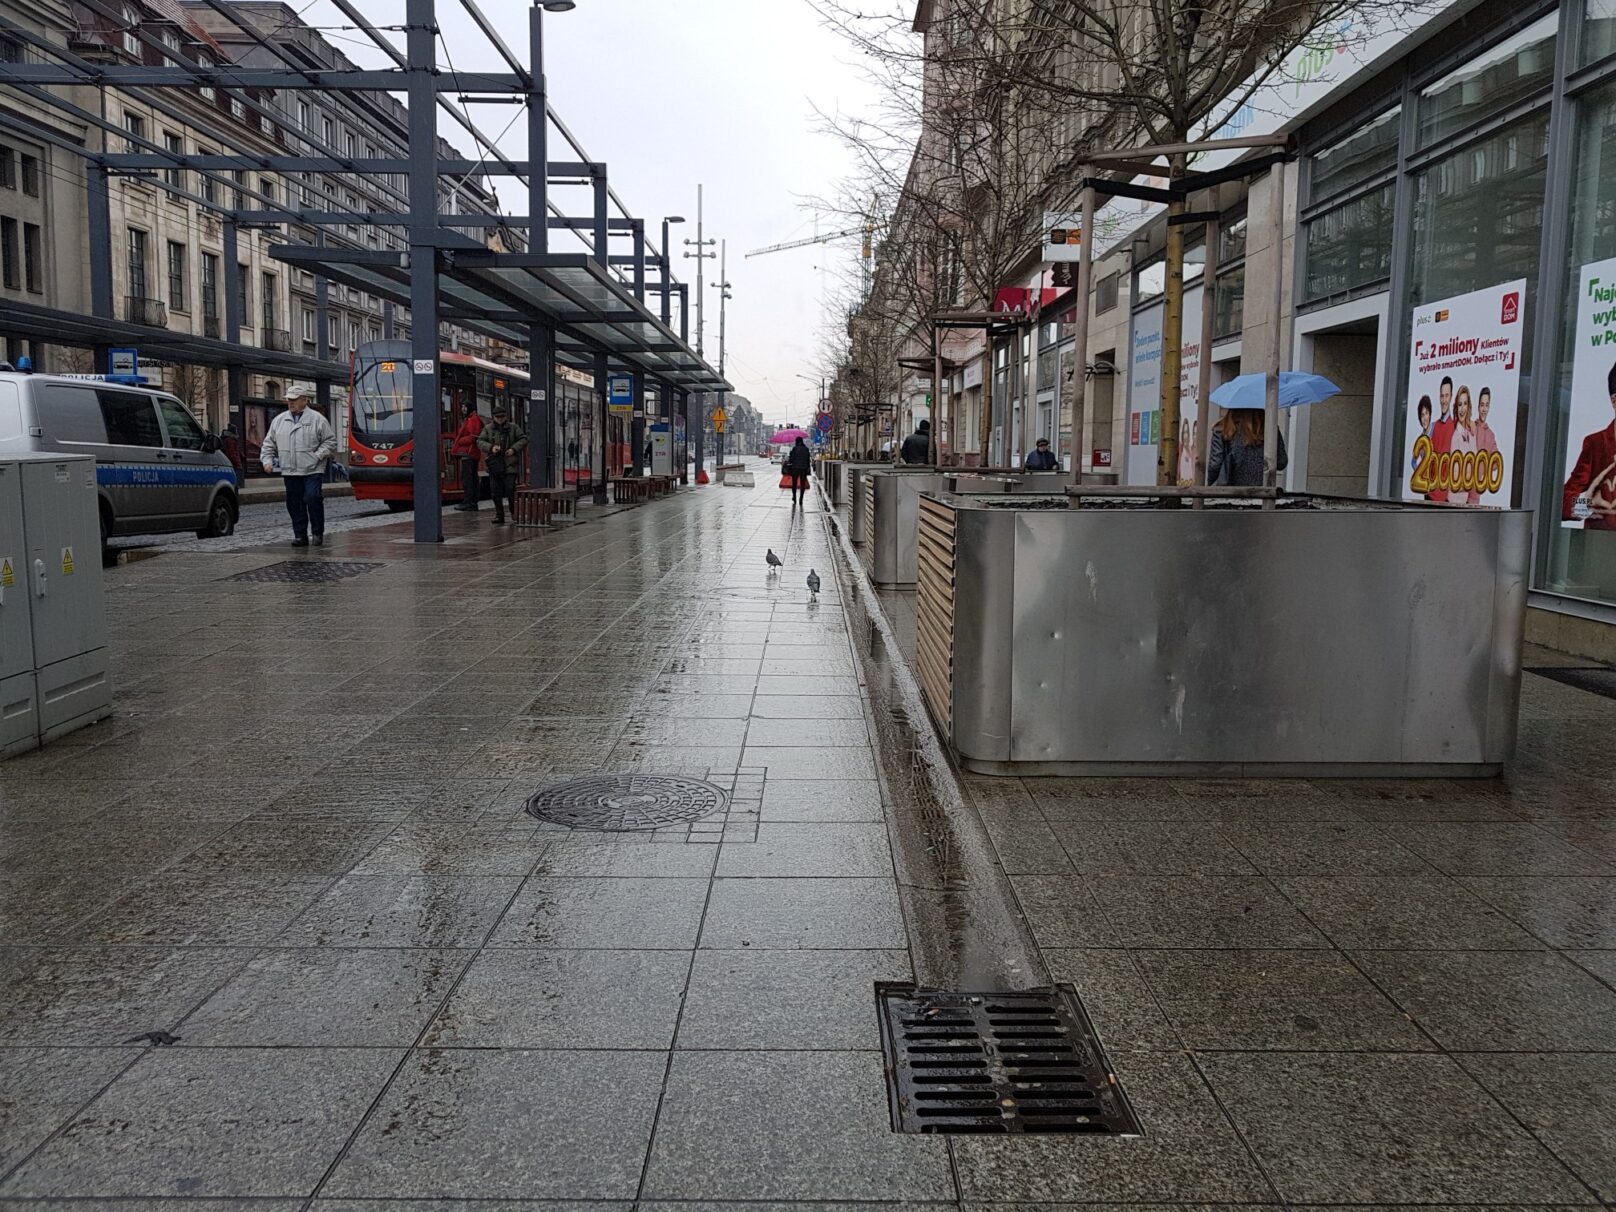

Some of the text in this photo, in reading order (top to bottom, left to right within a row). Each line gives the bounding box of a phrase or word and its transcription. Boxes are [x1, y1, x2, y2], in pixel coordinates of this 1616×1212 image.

[1594, 283, 1616, 304] Naj
[1430, 343, 1437, 359] 2
[1438, 336, 1479, 356] miliony
[1480, 336, 1509, 350] Klientów
[1591, 334, 1603, 347] w
[1419, 361, 1441, 374] wybrało
[1474, 353, 1495, 366] Dołącz
[133, 470, 159, 482] POLICJA
